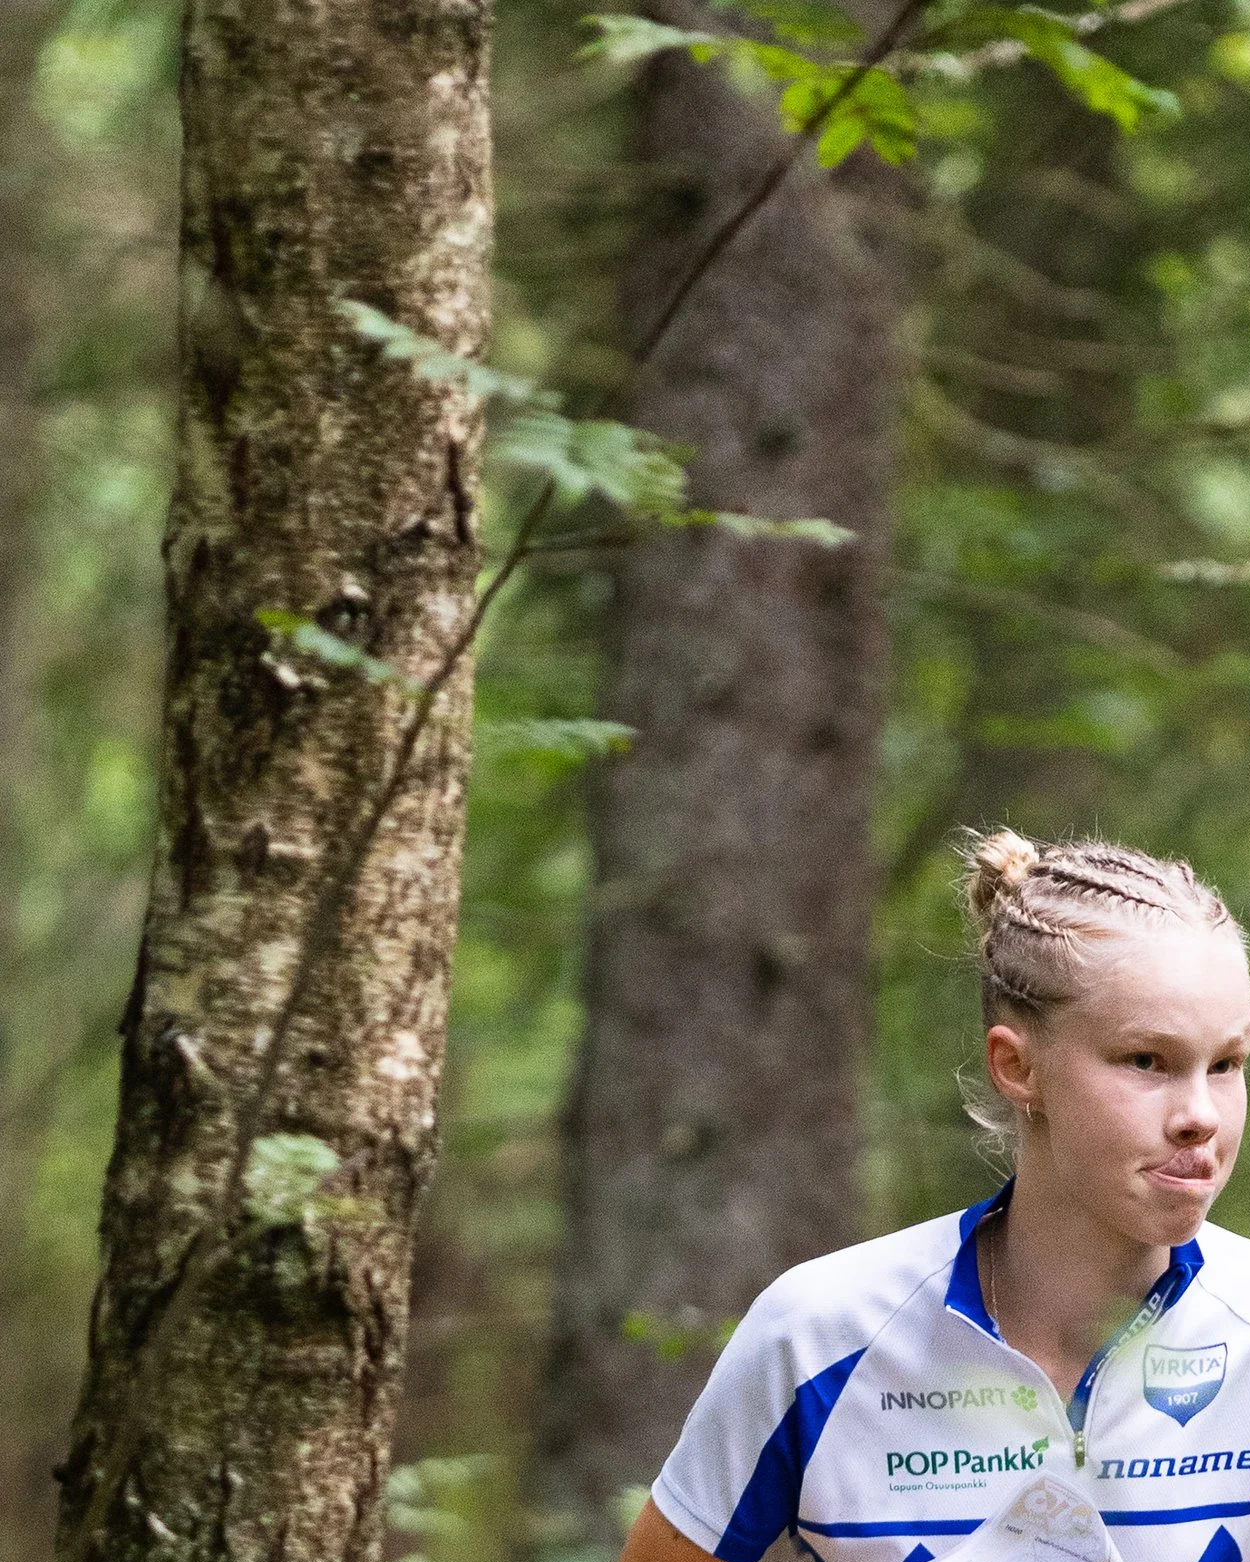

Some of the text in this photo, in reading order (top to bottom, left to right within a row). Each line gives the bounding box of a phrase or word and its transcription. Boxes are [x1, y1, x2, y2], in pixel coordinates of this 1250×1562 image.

[881, 1387, 1007, 1411] INNOPART
[1167, 1391, 1199, 1406] 1907
[887, 1445, 1045, 1476] POP Pankki
[889, 1479, 987, 1493] Lapuan Osuuspankki
